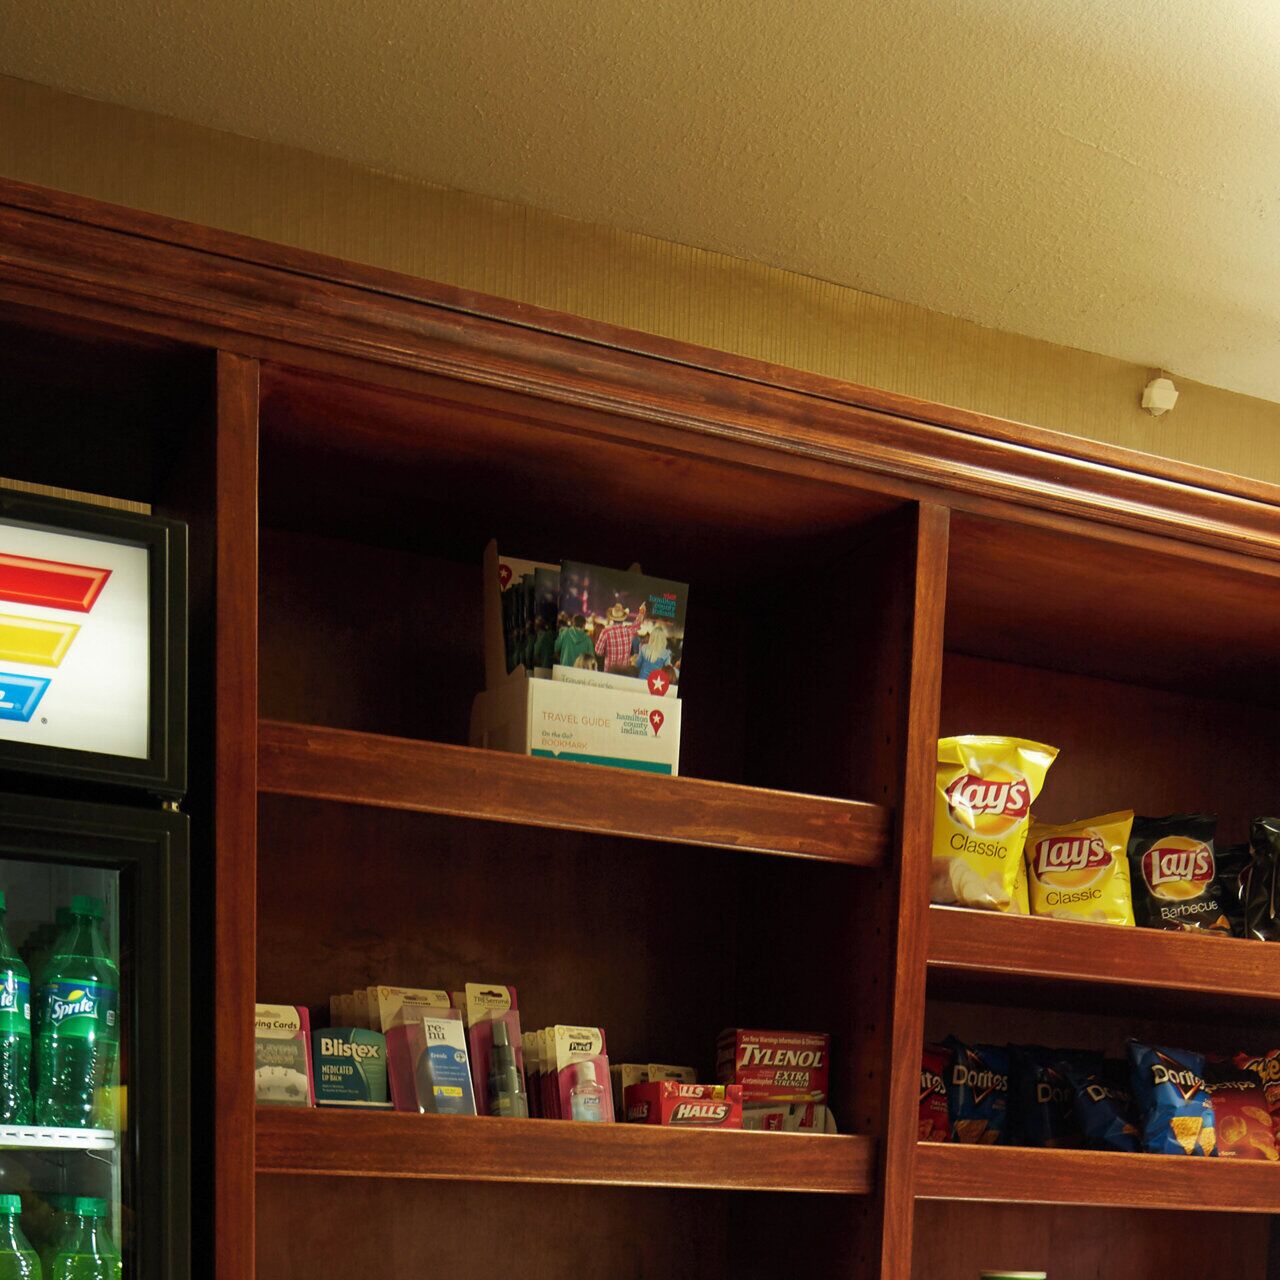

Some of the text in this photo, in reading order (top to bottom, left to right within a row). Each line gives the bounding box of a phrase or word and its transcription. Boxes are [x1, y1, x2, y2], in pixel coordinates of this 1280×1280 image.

[541, 711, 611, 728] TRAVEL GUIDE
[616, 713, 648, 723] hamilton
[623, 721, 648, 729] county
[621, 728, 648, 736] indiana
[951, 776, 1027, 815] Lay's
[950, 833, 1008, 860] Classic
[1037, 837, 1106, 873] Lay's
[1151, 848, 1210, 885] Lay's
[1046, 887, 1103, 906] Classic
[1160, 900, 1219, 920] Barbecue
[51, 999, 94, 1019] Sprite
[273, 1021, 297, 1030] Cards
[320, 1038, 380, 1063] Blistex
[740, 1044, 823, 1067] TYLENOL
[322, 1065, 354, 1075] MEDICATED
[775, 1071, 810, 1080] EXTRA
[952, 1064, 1008, 1091] Doritos
[679, 1085, 705, 1098] LLS
[920, 1071, 947, 1095] itos
[677, 1103, 727, 1119] HALLS
